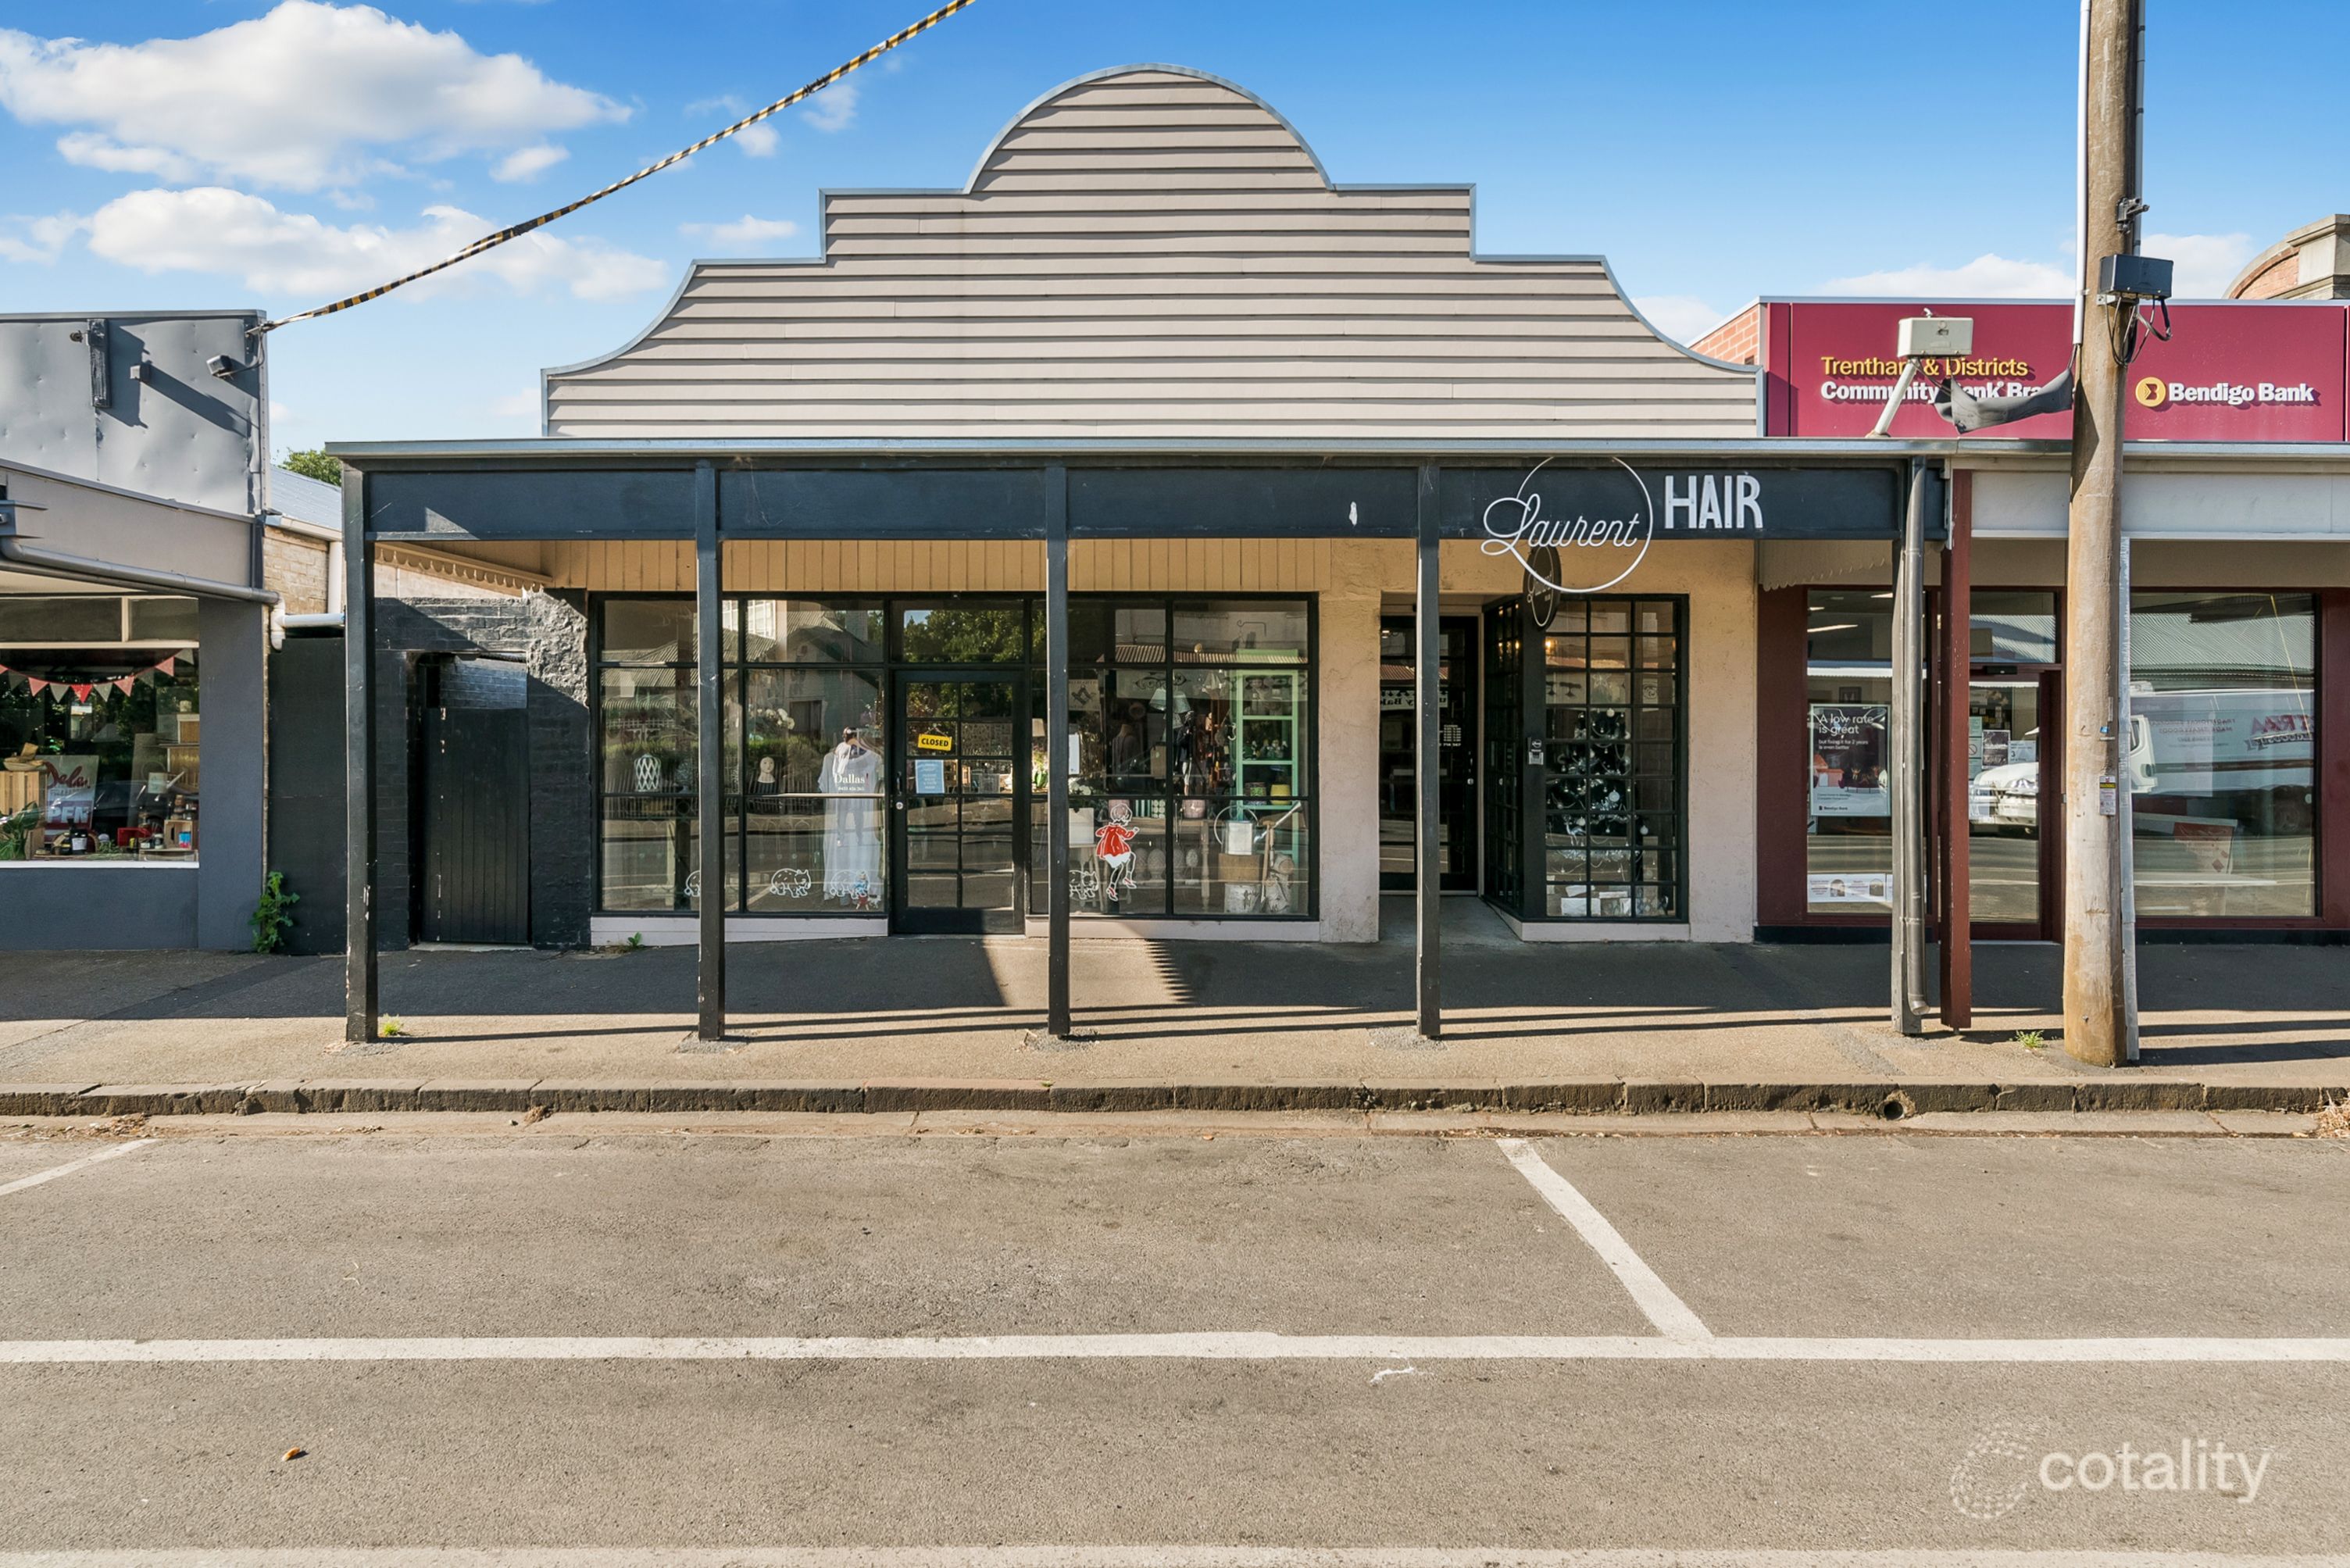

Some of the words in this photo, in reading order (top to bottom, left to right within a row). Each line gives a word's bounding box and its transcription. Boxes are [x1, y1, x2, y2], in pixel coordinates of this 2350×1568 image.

[1820, 356, 1916, 375] Trentha
[1923, 359, 1939, 375] &
[1945, 357, 2029, 376] Districts
[2007, 382, 2042, 398] Bra
[2169, 382, 2255, 405] Bendigo
[2259, 382, 2315, 402] Bank
[1664, 475, 1763, 529] HAIR
[1481, 494, 1640, 555] Laurent
[1820, 713, 1828, 723] A
[1830, 713, 1850, 723] low
[1852, 715, 1873, 723] rate
[1819, 723, 1828, 734] is
[1830, 725, 1859, 736] great
[921, 738, 949, 747] CLOSED
